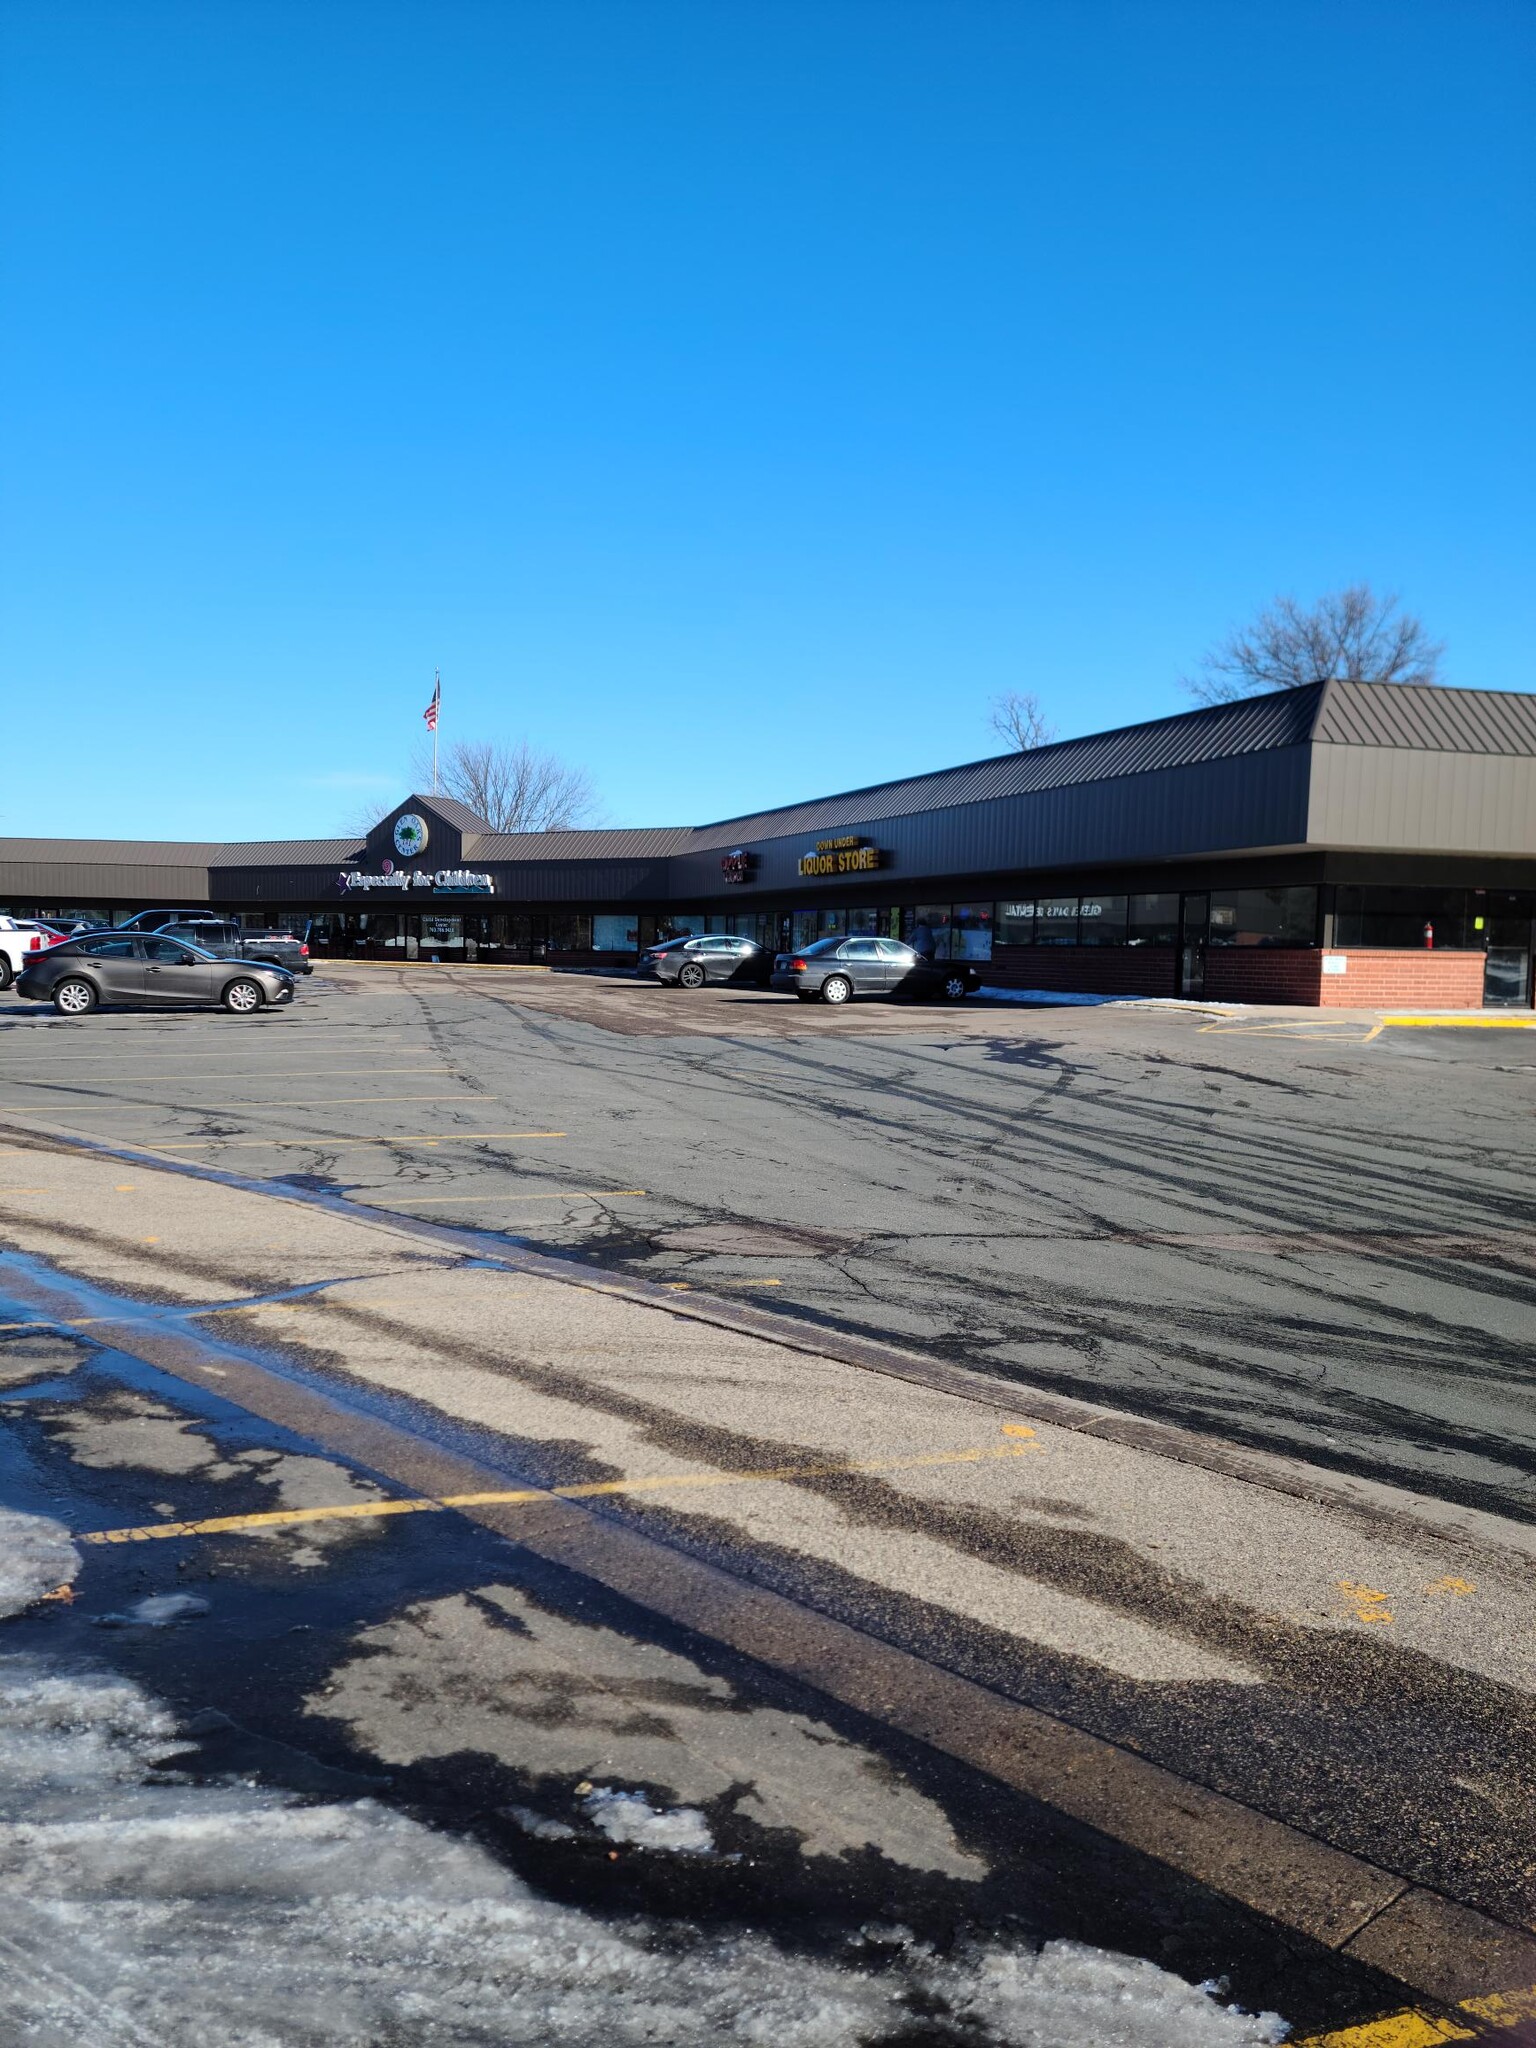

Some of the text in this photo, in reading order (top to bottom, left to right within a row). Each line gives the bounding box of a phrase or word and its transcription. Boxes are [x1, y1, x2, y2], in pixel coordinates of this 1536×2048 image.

[395, 839, 419, 855] CENTER
[834, 835, 855, 848] UNDER
[798, 847, 875, 876] LIQUOR STORE
[350, 869, 492, 891] Especially for Children
